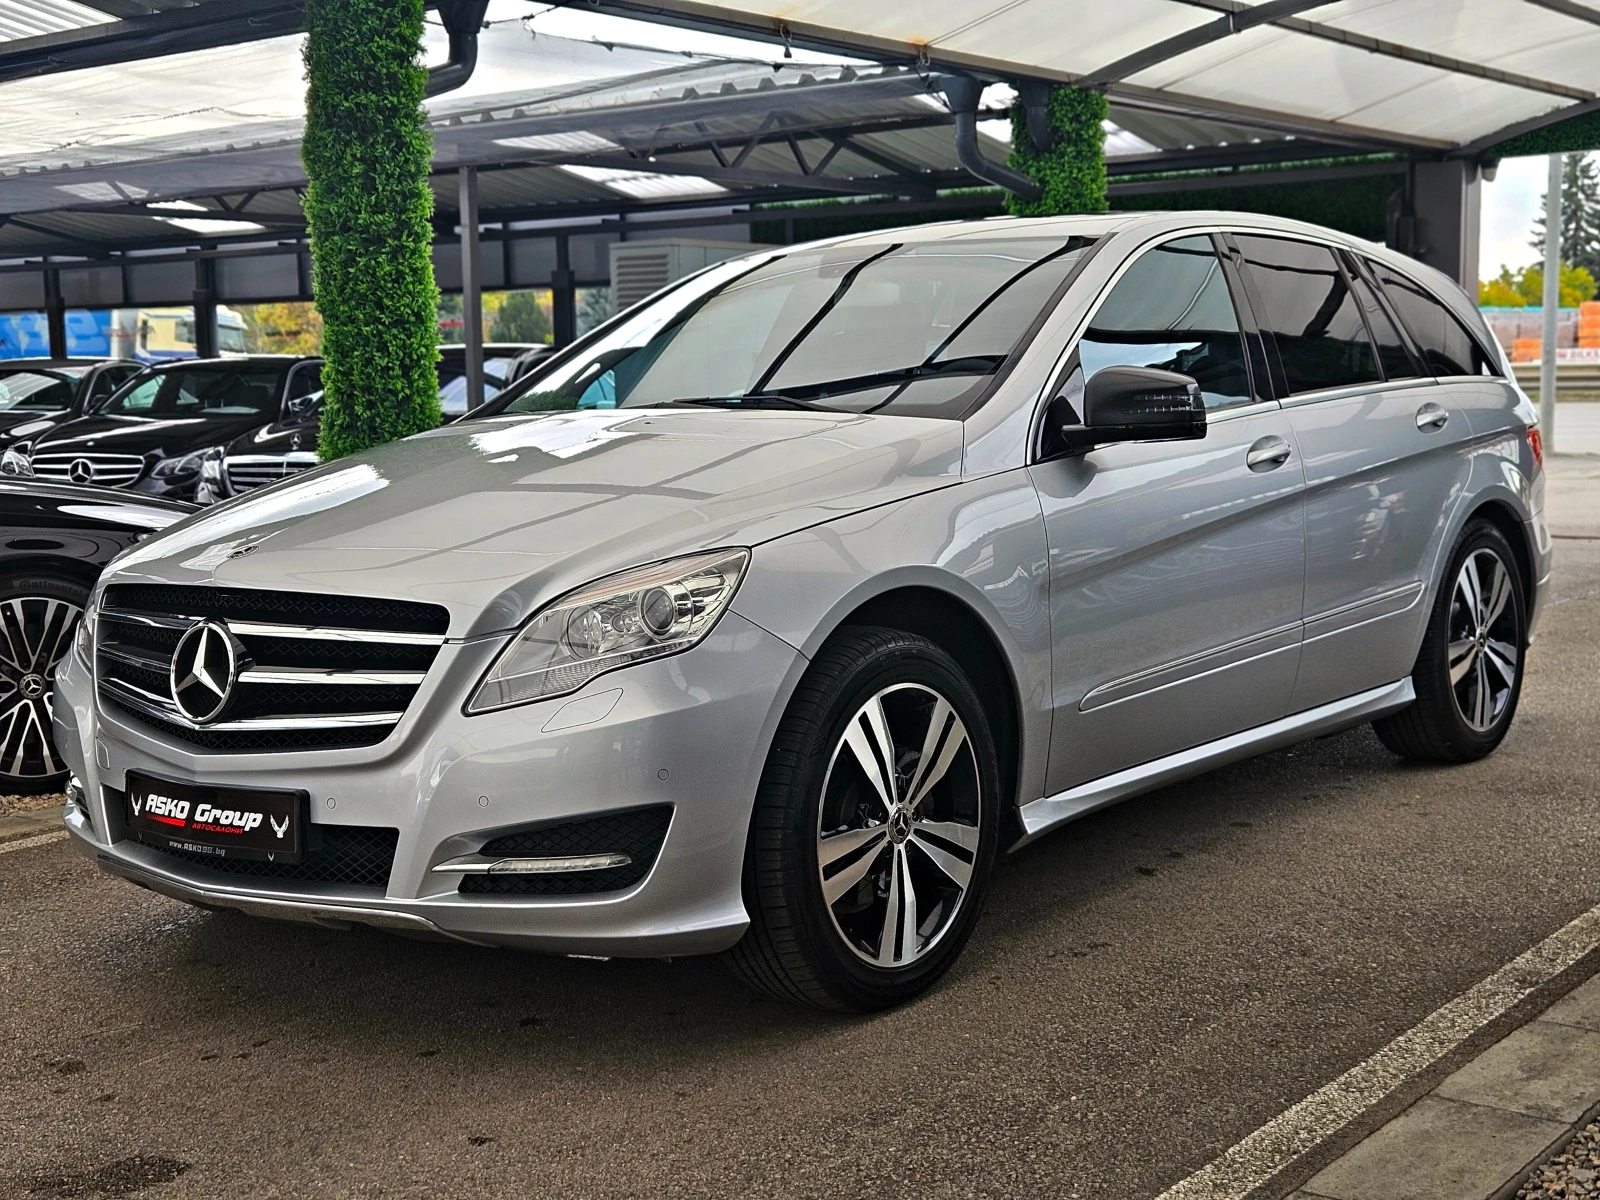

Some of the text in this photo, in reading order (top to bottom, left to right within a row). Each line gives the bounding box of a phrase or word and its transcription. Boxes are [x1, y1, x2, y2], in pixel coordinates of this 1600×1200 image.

[145, 794, 263, 832] ASKO Group
[192, 822, 243, 835] АВТОСАЛОНИ
